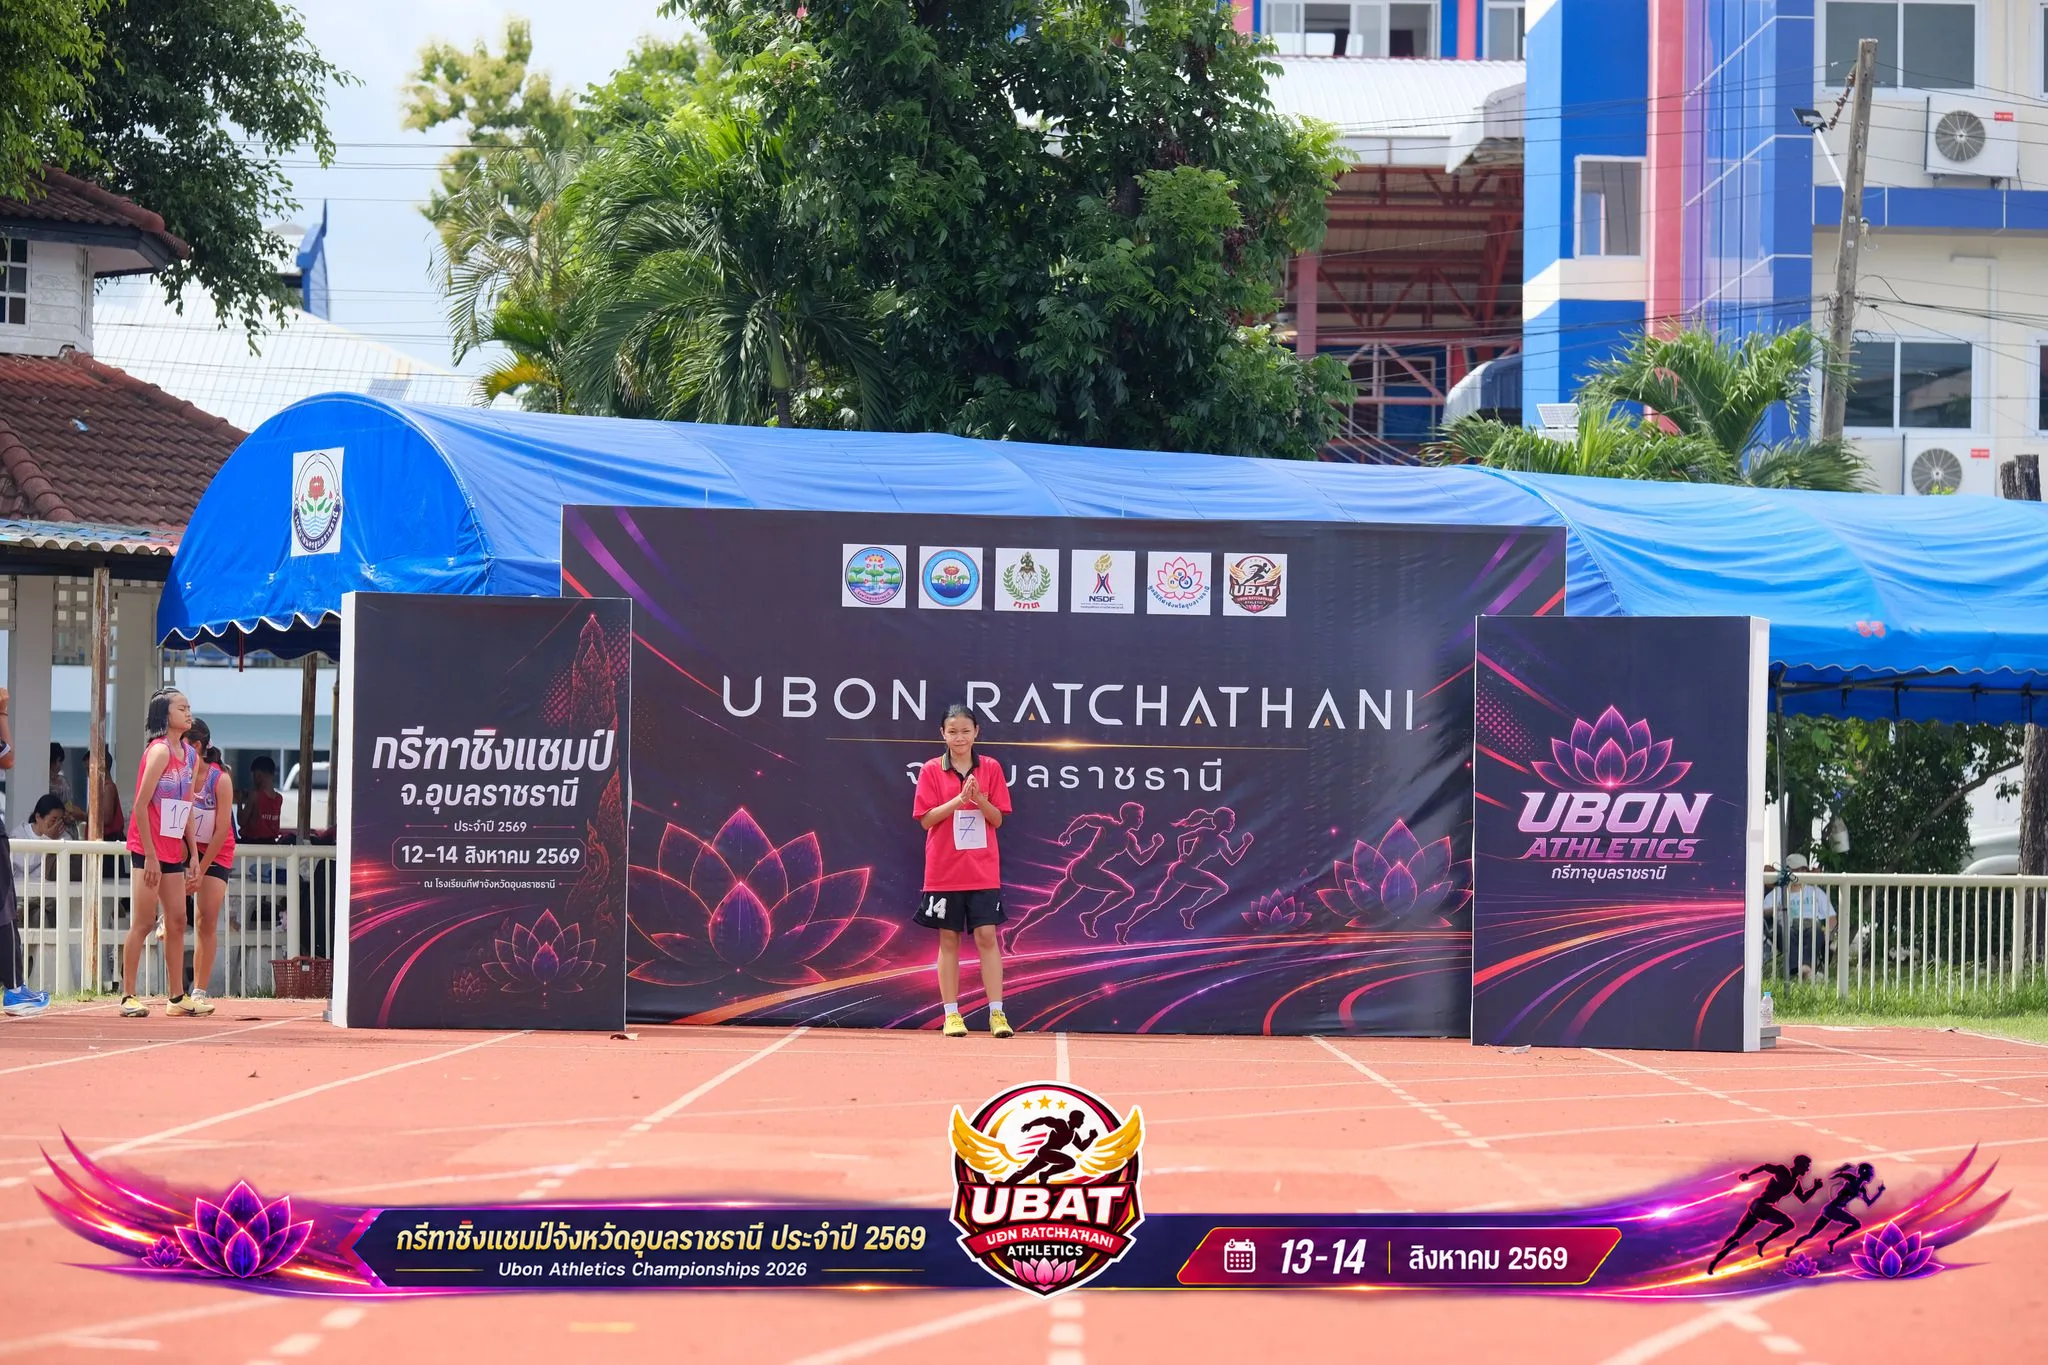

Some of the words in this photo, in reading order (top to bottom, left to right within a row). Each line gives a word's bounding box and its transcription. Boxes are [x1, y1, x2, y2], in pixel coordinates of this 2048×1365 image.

[1234, 585, 1277, 596] UBAT
[723, 675, 927, 721] UBON
[966, 681, 1414, 731] RATCHATHANI
[372, 726, 615, 772] กรีฑาชิงแชมป์
[400, 777, 580, 815] จ.อุบลราชธานี
[1517, 791, 1713, 834] UBON
[454, 819, 495, 832] ประจำปี
[498, 821, 527, 832] 2569
[959, 816, 976, 841] 7
[464, 845, 530, 864] สิงหาคม
[536, 847, 580, 865] 2569
[1518, 837, 1703, 859] ATHLETICS
[424, 880, 433, 889] ณ
[925, 895, 947, 919] 14
